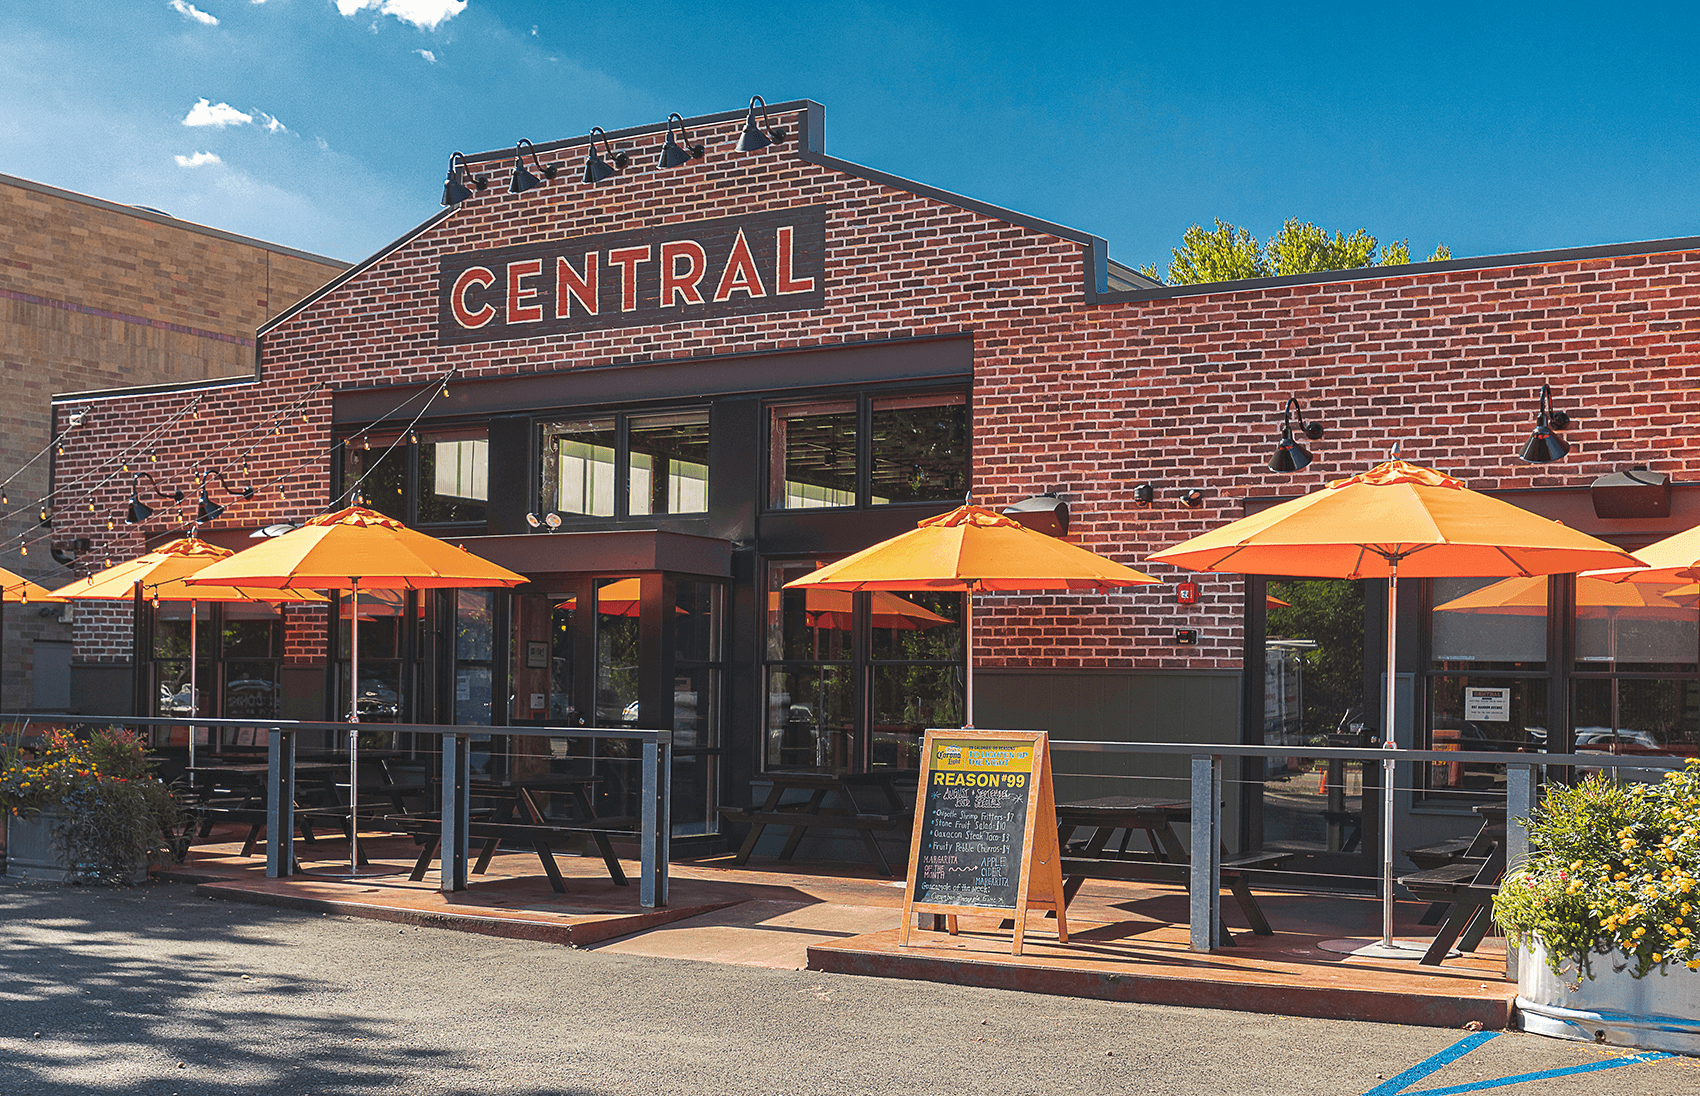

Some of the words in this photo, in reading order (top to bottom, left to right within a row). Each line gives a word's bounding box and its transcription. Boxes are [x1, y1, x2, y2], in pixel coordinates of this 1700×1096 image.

[450, 226, 815, 329] CENTRAL
[936, 751, 961, 760] Corona
[981, 751, 1014, 759] LIGHTEN
[934, 772, 1000, 787] REASON
[1001, 774, 1025, 788] #99
[936, 809, 957, 819] Chipotle
[960, 810, 978, 821] Shrimp
[936, 819, 952, 828] Stone
[954, 820, 970, 828] Fruit
[965, 830, 984, 840] Steak
[933, 842, 952, 854] Fruity
[956, 842, 974, 852] Pebble
[923, 856, 958, 864] MARGARITA
[980, 856, 1006, 867] APPLE
[924, 870, 945, 879] MONTH
[980, 868, 1002, 876] CIDER
[975, 877, 1010, 887] MARGARITA
[952, 883, 961, 892] of
